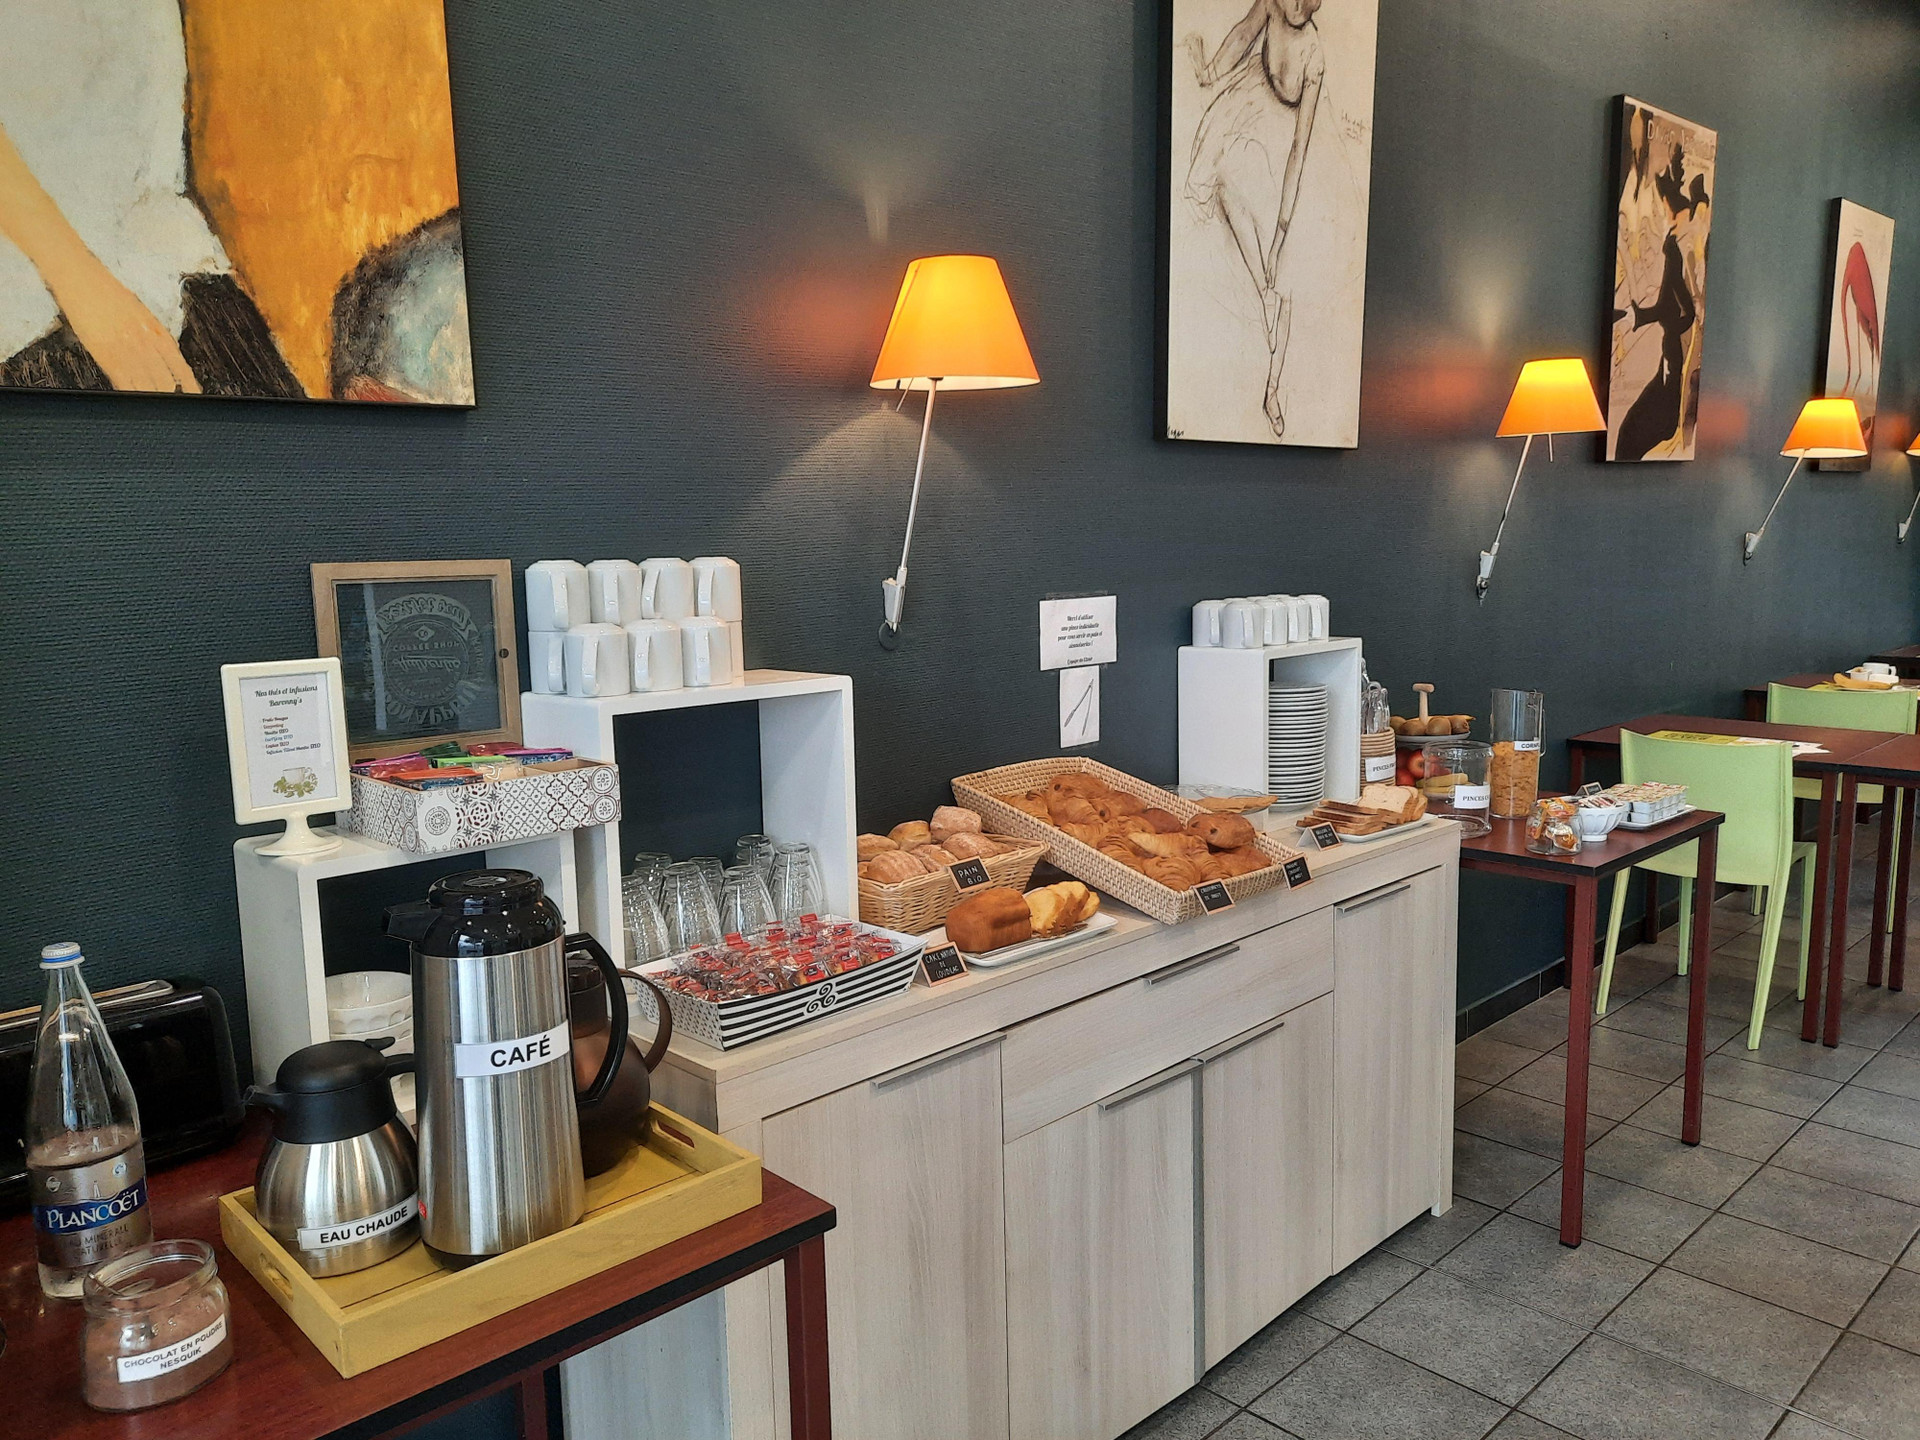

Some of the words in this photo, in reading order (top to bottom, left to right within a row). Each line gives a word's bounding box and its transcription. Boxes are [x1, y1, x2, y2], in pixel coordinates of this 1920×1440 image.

[957, 865, 978, 879] PAIN
[925, 951, 941, 964] CAKE
[490, 1034, 551, 1068] CAFÉ
[46, 1189, 139, 1229] PLANCOËT
[320, 1228, 351, 1244] EAU
[355, 1205, 408, 1237] CHAUDE
[123, 1347, 178, 1369] CHOCOLAT
[180, 1341, 193, 1353] EN
[195, 1321, 223, 1346] POUDRE
[160, 1346, 202, 1370] NESQUIK
